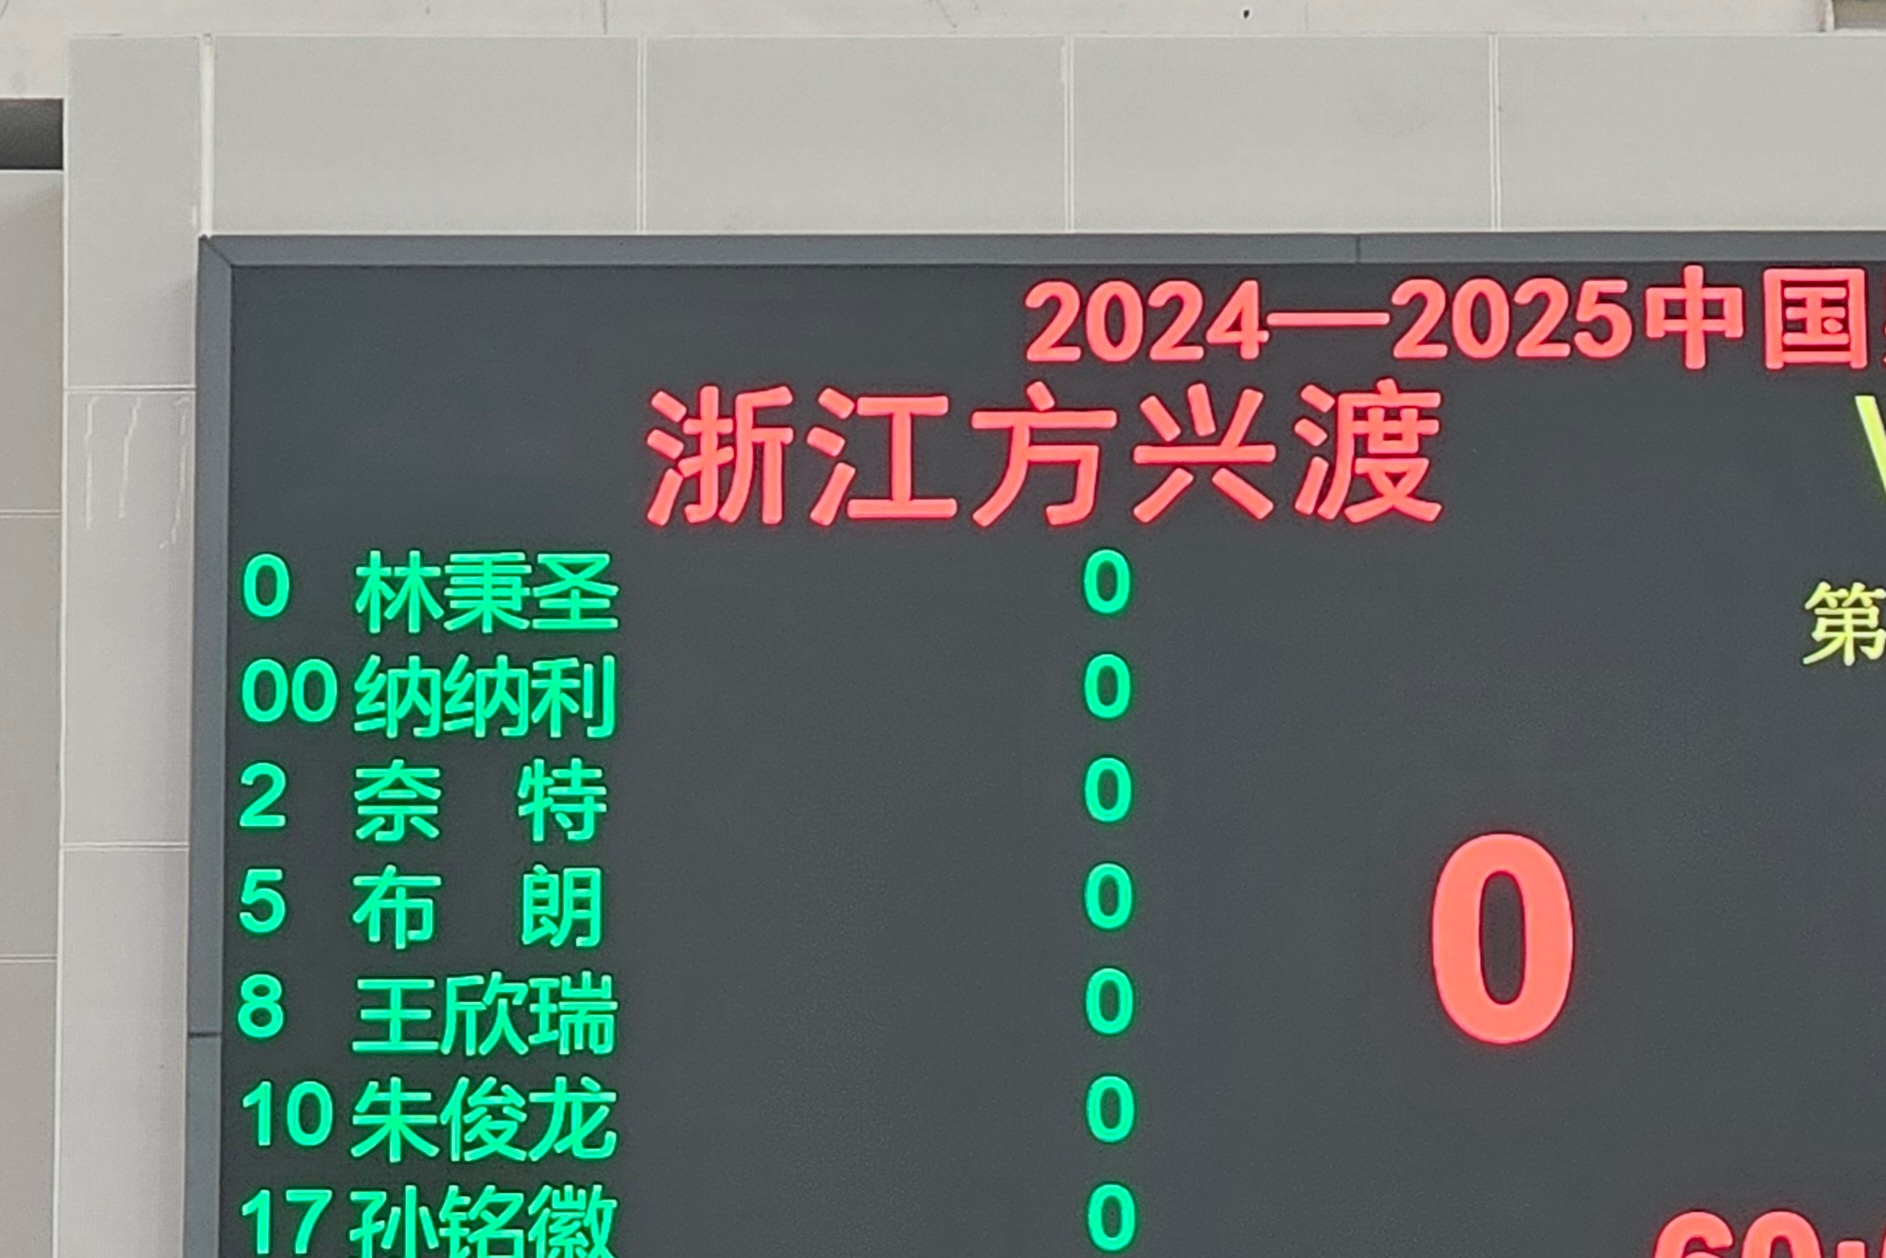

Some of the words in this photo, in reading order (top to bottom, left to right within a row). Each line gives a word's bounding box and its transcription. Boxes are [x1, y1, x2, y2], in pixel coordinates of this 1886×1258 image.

[644, 376, 1444, 530] 浙江方兴渡
[241, 551, 292, 620] 0
[353, 548, 621, 636] 林秉圣
[1081, 547, 1133, 616] 0
[239, 656, 340, 725] 00
[351, 651, 617, 741] 纳纳利
[1082, 651, 1133, 721] 0
[237, 760, 288, 830] 2
[1082, 755, 1134, 824] 0
[237, 866, 288, 936] 5
[1082, 861, 1135, 932] 0
[1429, 831, 1576, 1047] 0
[235, 971, 286, 1041] 8
[350, 968, 620, 1059] 王欣瑞
[1083, 965, 1136, 1037] 0
[240, 1078, 335, 1148] 10
[348, 1074, 619, 1165] 朱俊龙
[1084, 1073, 1137, 1145] 0
[239, 1187, 335, 1257] 17
[1085, 1181, 1138, 1253] 0
